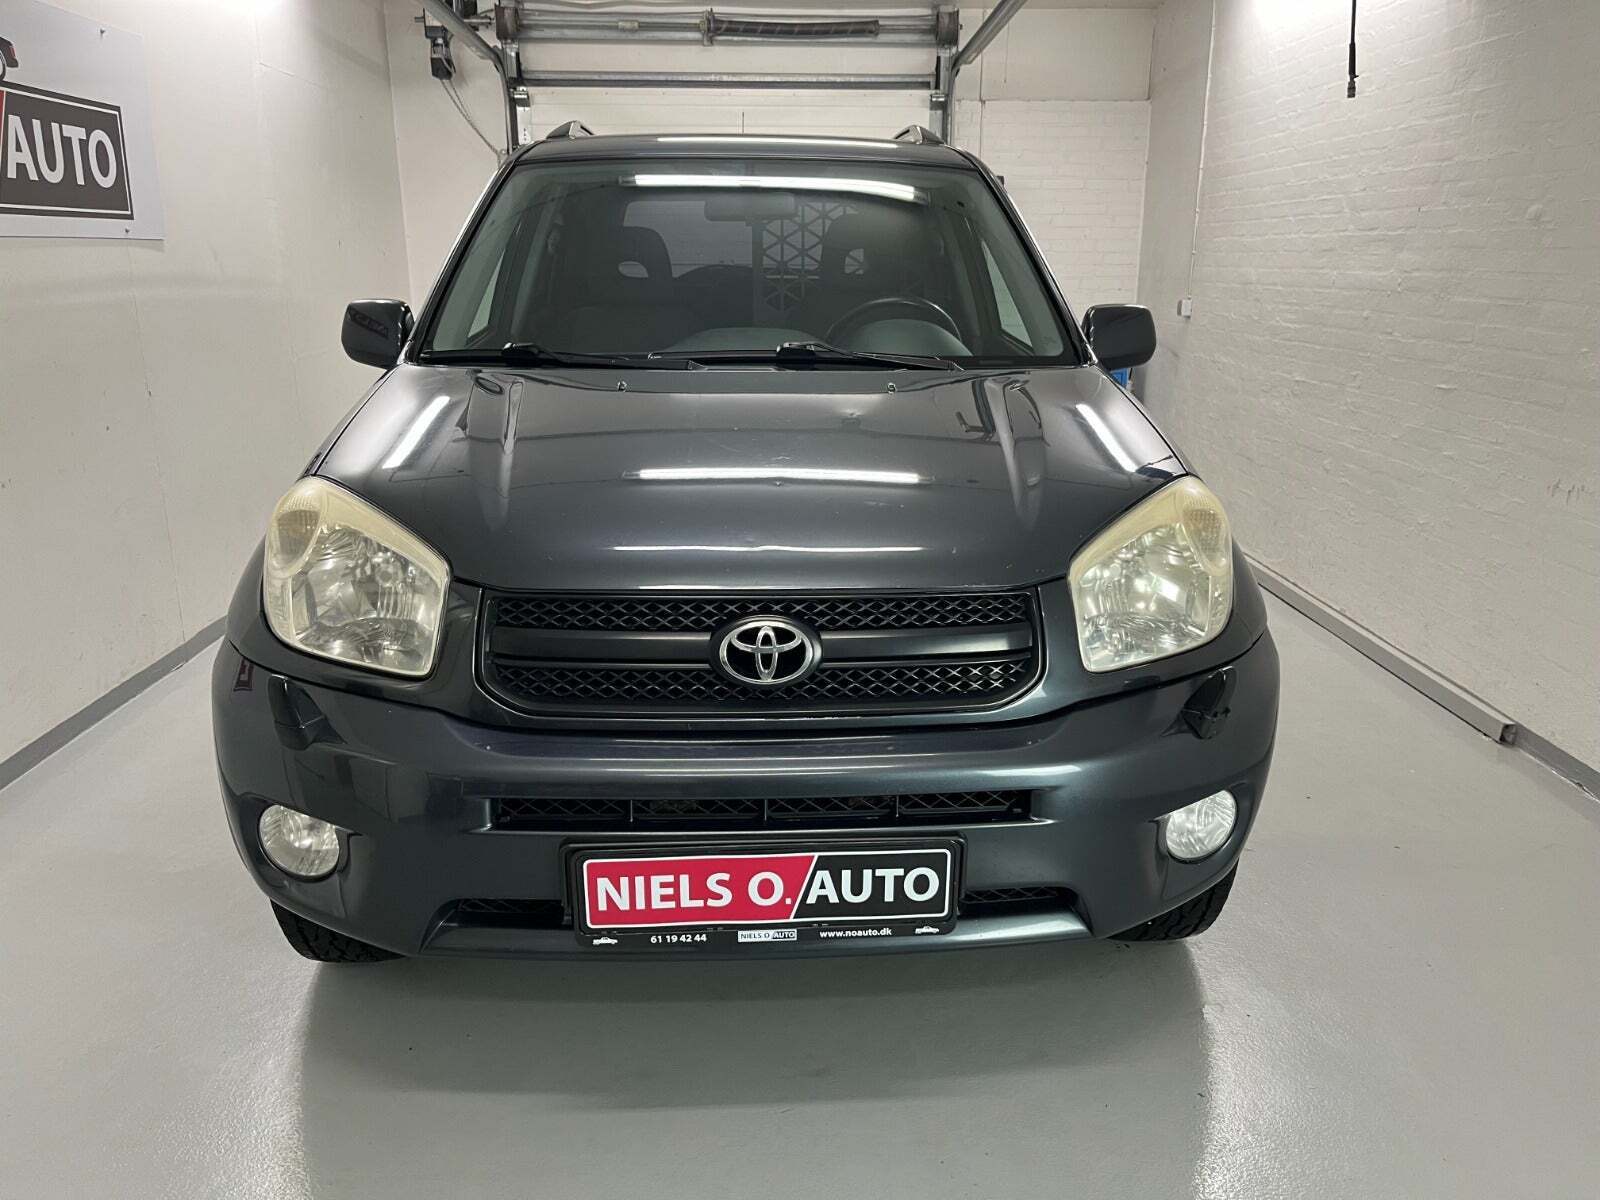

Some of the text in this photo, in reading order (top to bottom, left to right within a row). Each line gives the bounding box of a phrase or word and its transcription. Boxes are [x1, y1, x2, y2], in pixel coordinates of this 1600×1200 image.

[7, 114, 117, 189] AUTO
[596, 866, 940, 911] NIELS O. AUTO
[740, 932, 762, 940] NIELS
[772, 931, 796, 939] AUTO
[819, 927, 893, 938] www.noauto.dk
[650, 933, 707, 944] 61 19 42 44
